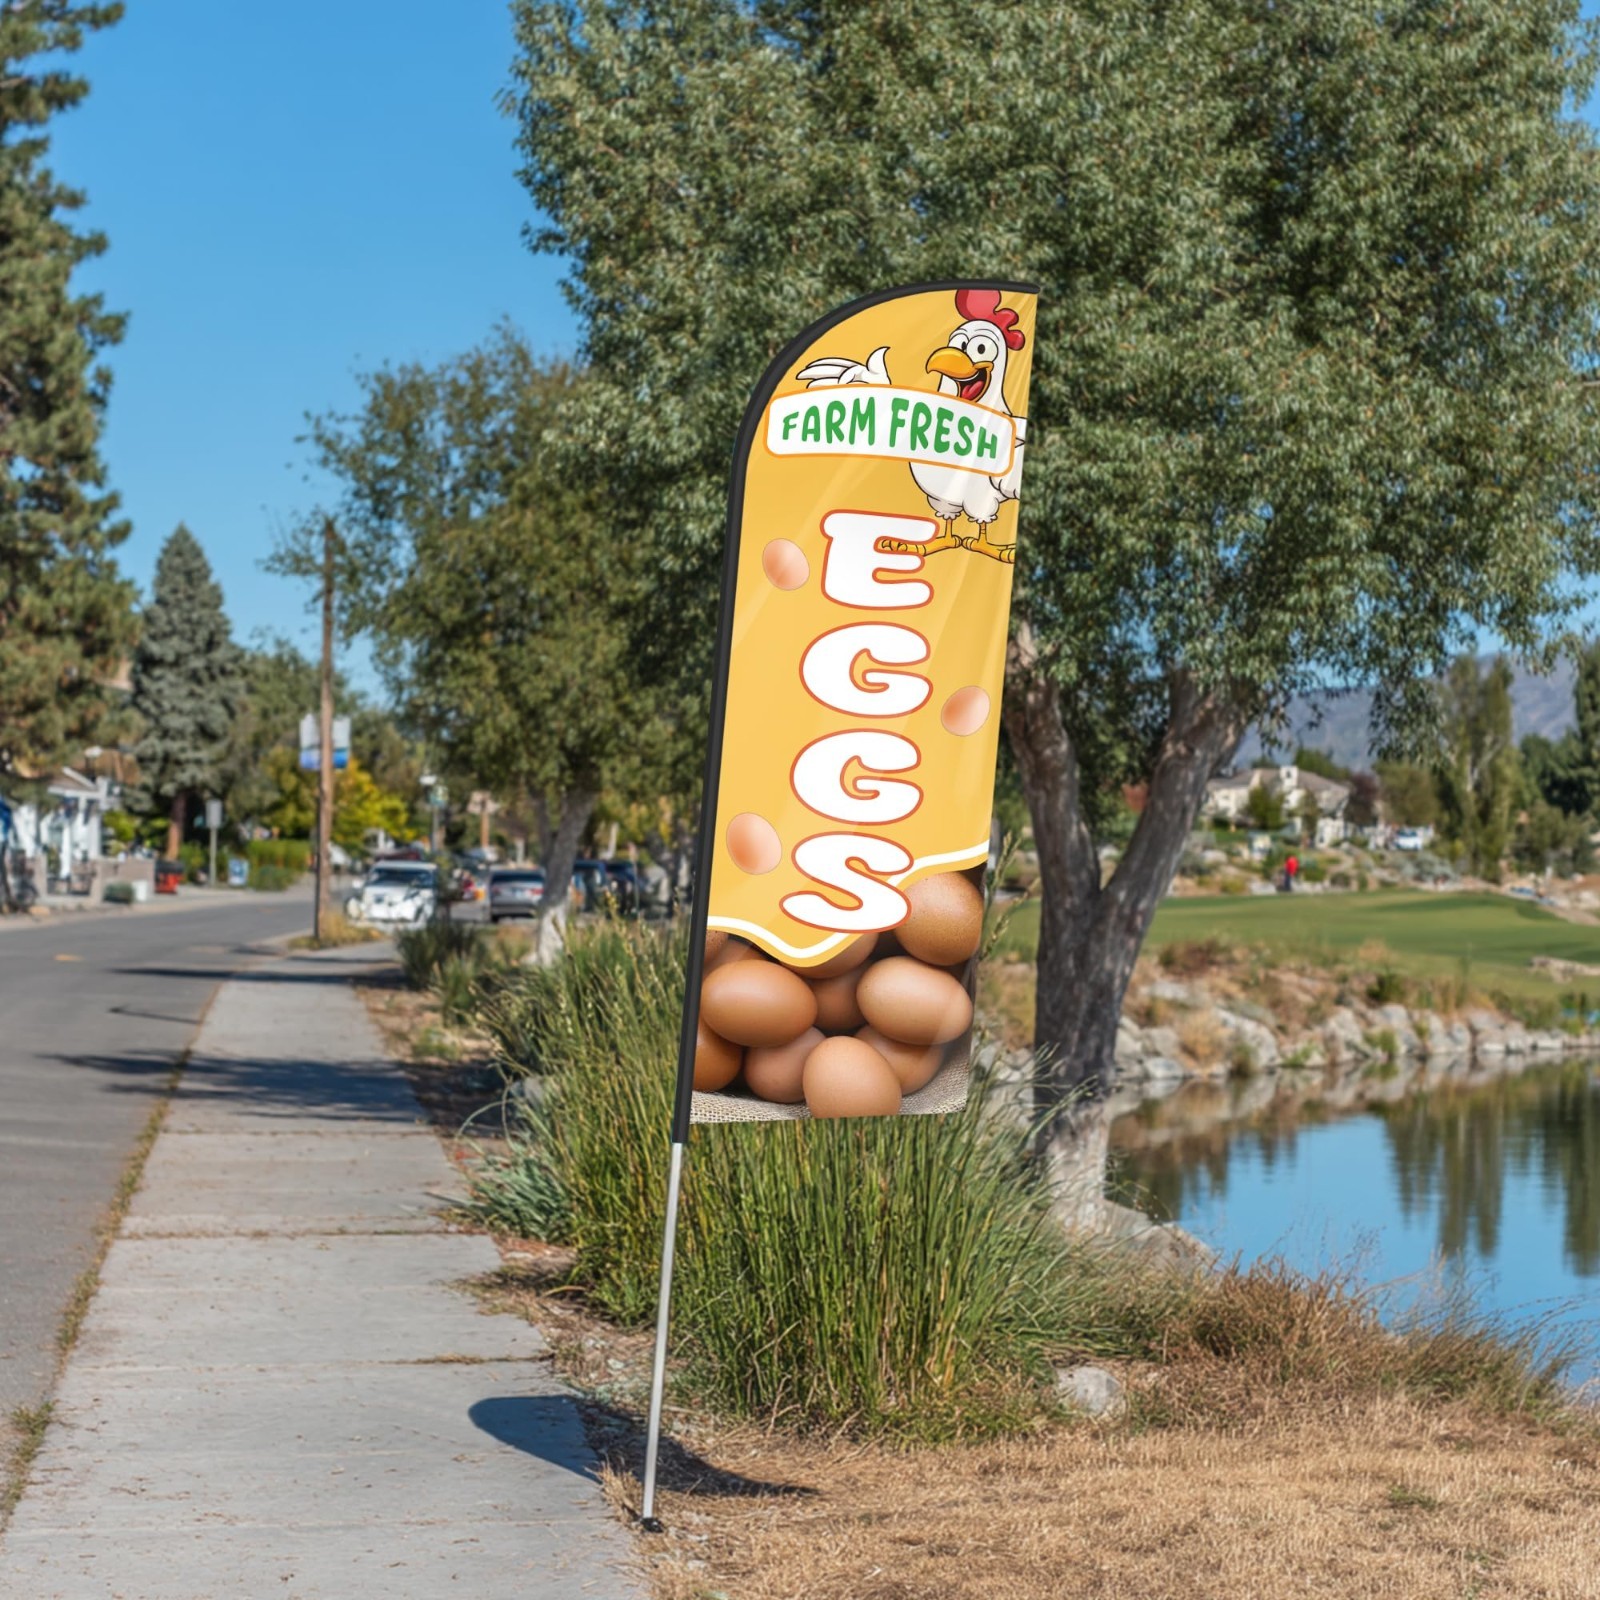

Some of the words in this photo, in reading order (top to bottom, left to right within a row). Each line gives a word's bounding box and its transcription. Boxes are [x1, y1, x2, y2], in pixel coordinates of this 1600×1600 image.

[782, 397, 876, 446] FARM
[889, 397, 998, 459] FRESH
[779, 509, 940, 934] EGGS
